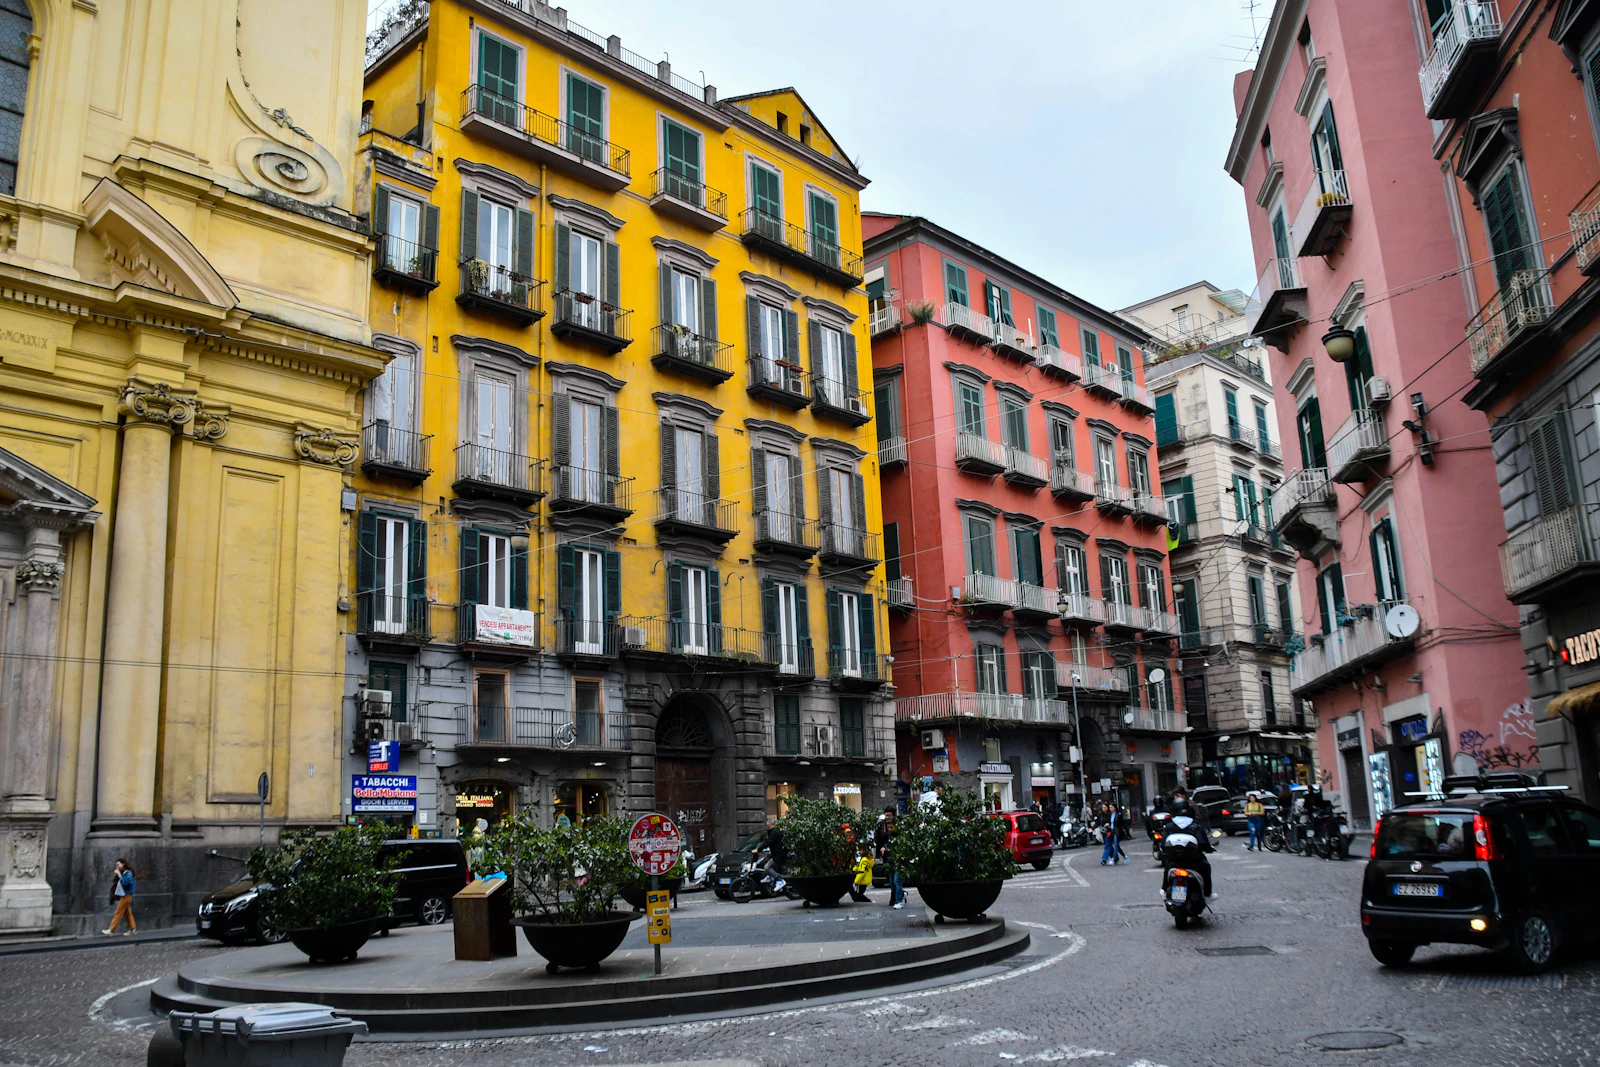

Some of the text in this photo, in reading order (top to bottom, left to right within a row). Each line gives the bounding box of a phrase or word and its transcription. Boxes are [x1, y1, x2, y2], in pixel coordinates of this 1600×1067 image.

[479, 620, 532, 632] VENDESI APPARTAMENTO
[379, 741, 390, 762] T
[981, 764, 1011, 773] OUTLETMANIA
[361, 777, 408, 787] TABACCHI
[1398, 883, 1438, 896] EZ 269XS
